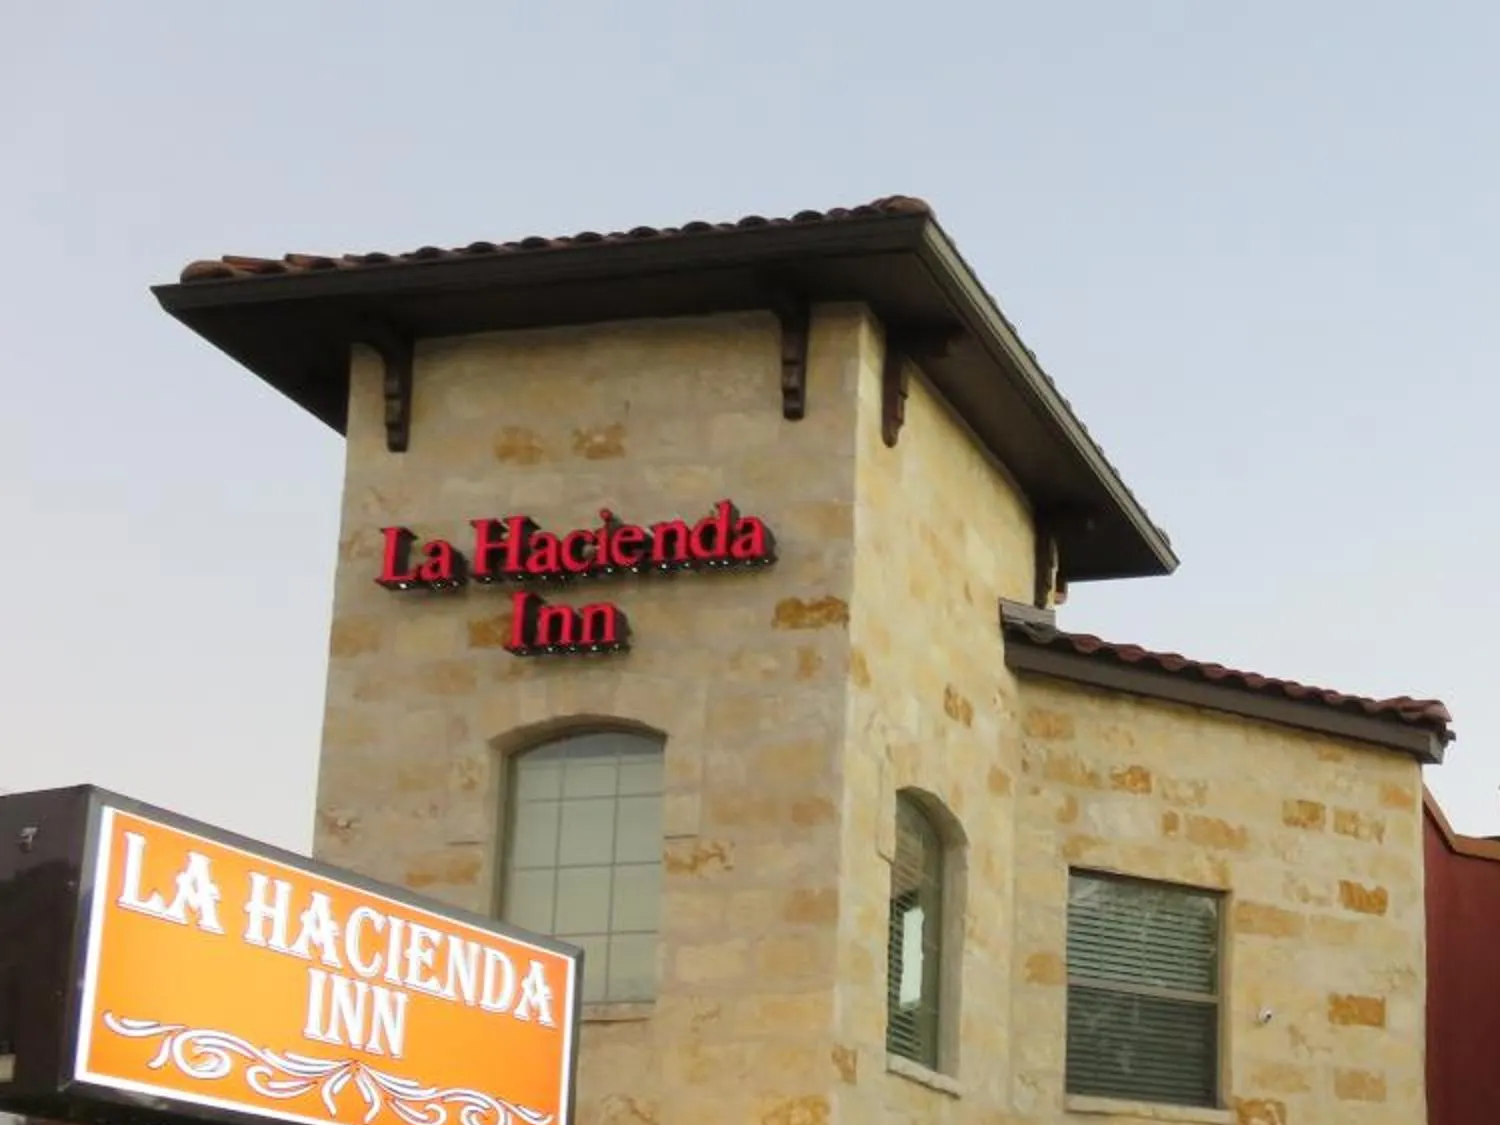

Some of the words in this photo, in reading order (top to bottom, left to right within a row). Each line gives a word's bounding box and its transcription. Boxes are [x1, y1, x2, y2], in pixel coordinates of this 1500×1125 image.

[378, 526, 464, 588] La
[471, 499, 775, 579] Hacienda
[507, 590, 628, 653] Inn
[117, 831, 227, 936] LA
[242, 868, 559, 1029] HACIENDA
[302, 967, 411, 1060] INN
